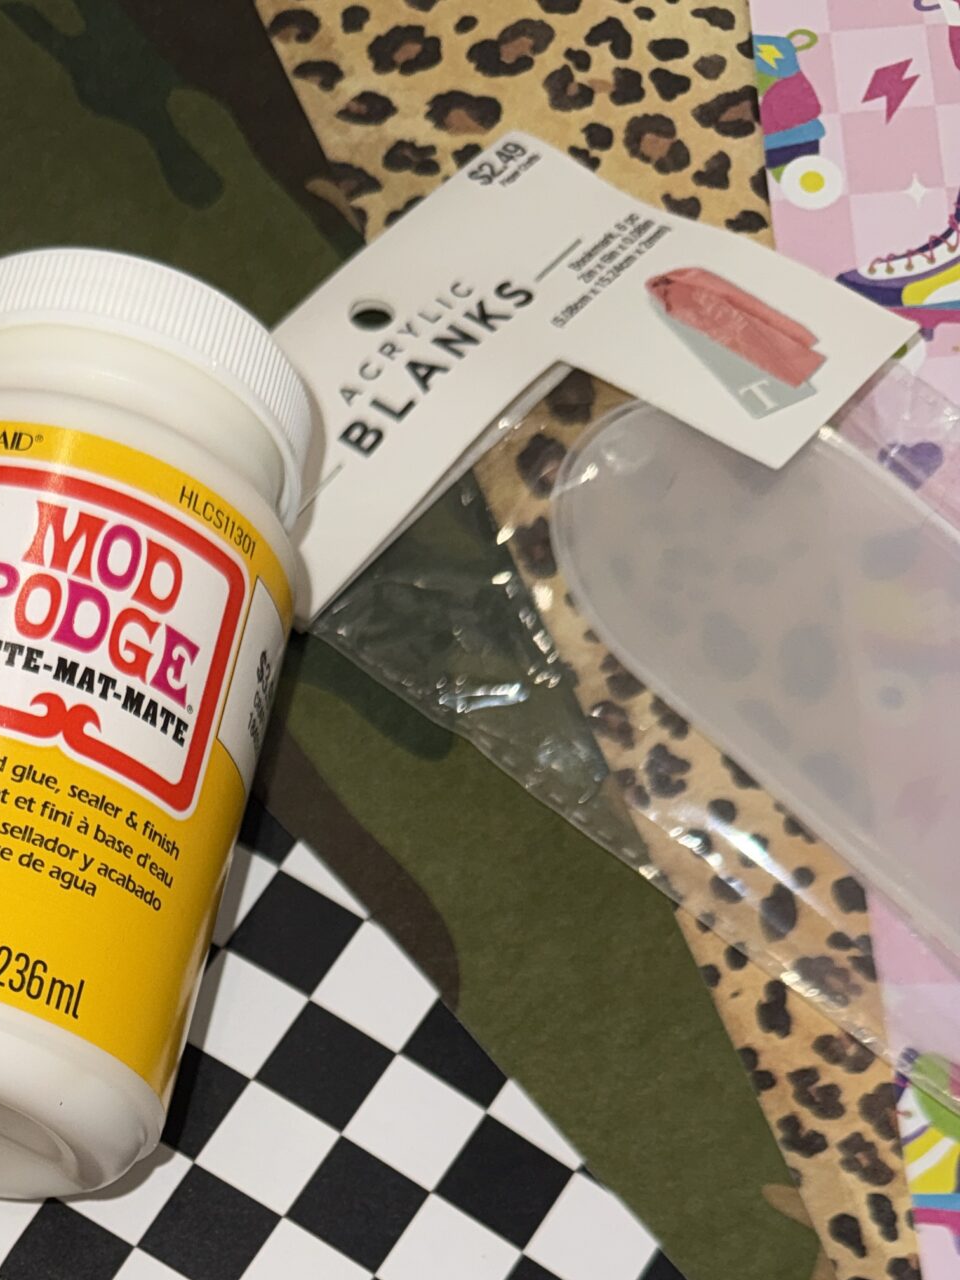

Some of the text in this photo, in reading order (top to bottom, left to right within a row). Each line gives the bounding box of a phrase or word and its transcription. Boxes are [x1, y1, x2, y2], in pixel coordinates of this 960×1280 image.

[467, 141, 527, 186] $2.49
[337, 280, 535, 458] BLANKS
[339, 281, 475, 407] ACRYLIC
[22, 499, 184, 614] MOD
[178, 485, 257, 560] HLCS11301
[10, 764, 61, 794] glue,
[67, 784, 123, 819] sealer
[125, 811, 139, 831] &
[141, 820, 180, 861] finish
[14, 794, 37, 813] et
[39, 801, 75, 828] fini
[76, 816, 90, 836] à
[93, 824, 134, 860] base
[136, 852, 174, 889] d'eau
[0, 821, 79, 861] sellador
[78, 853, 95, 872] y
[97, 862, 162, 912] acabado
[18, 852, 45, 873] de
[48, 864, 98, 898] agua
